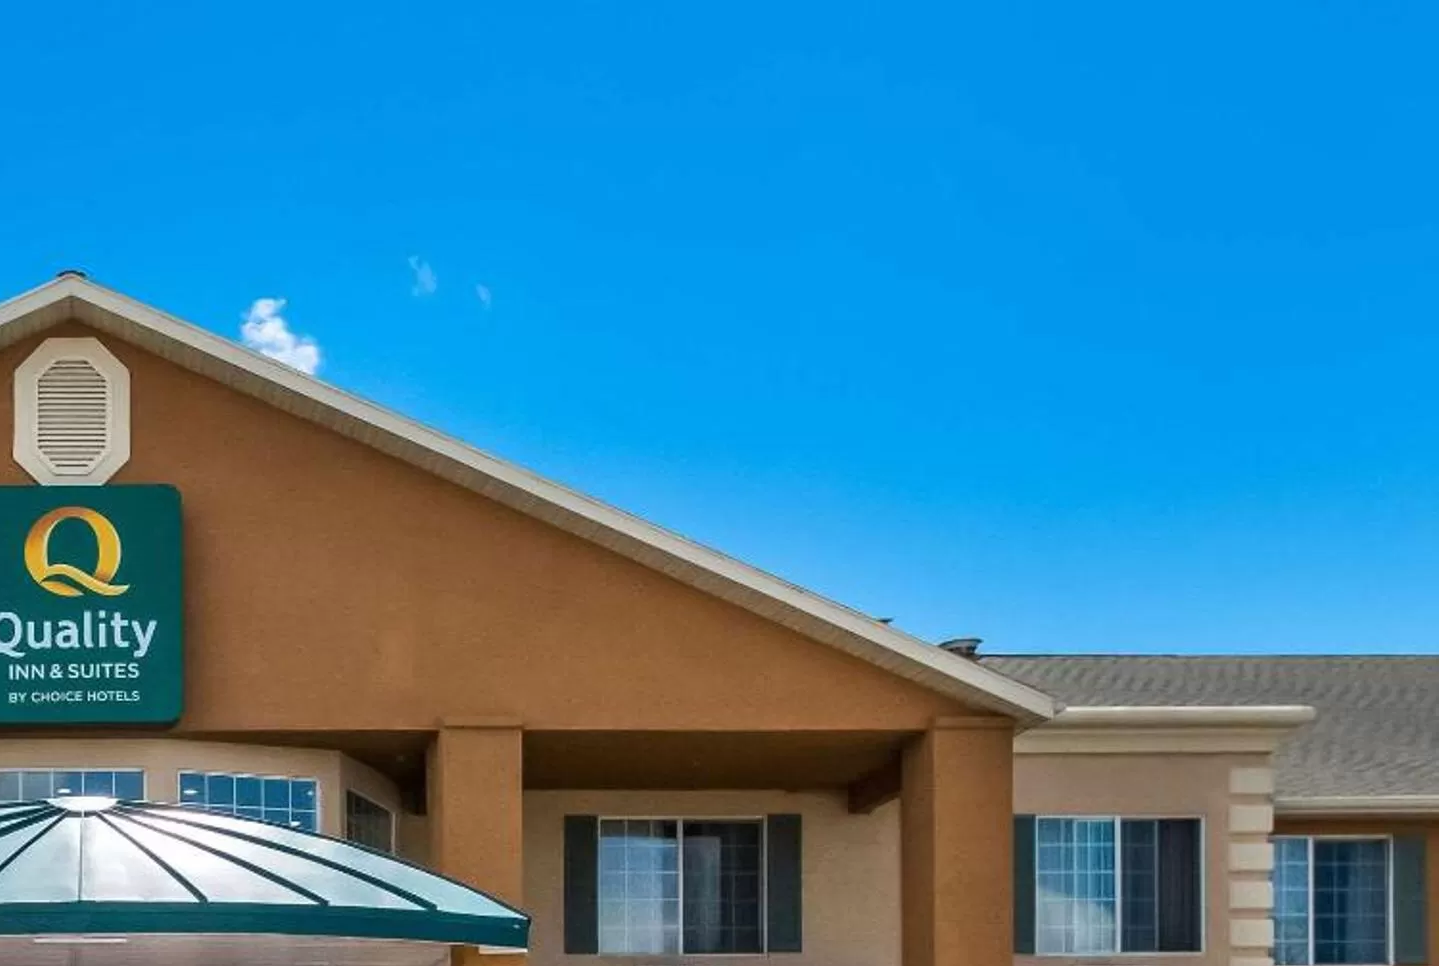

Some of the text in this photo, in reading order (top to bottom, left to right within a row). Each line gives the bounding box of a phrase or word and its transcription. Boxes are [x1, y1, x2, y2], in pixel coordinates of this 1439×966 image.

[24, 506, 130, 596] Q
[8, 662, 140, 680] INN & SUITES
[8, 690, 140, 703] BY CHOICE HOTELS
